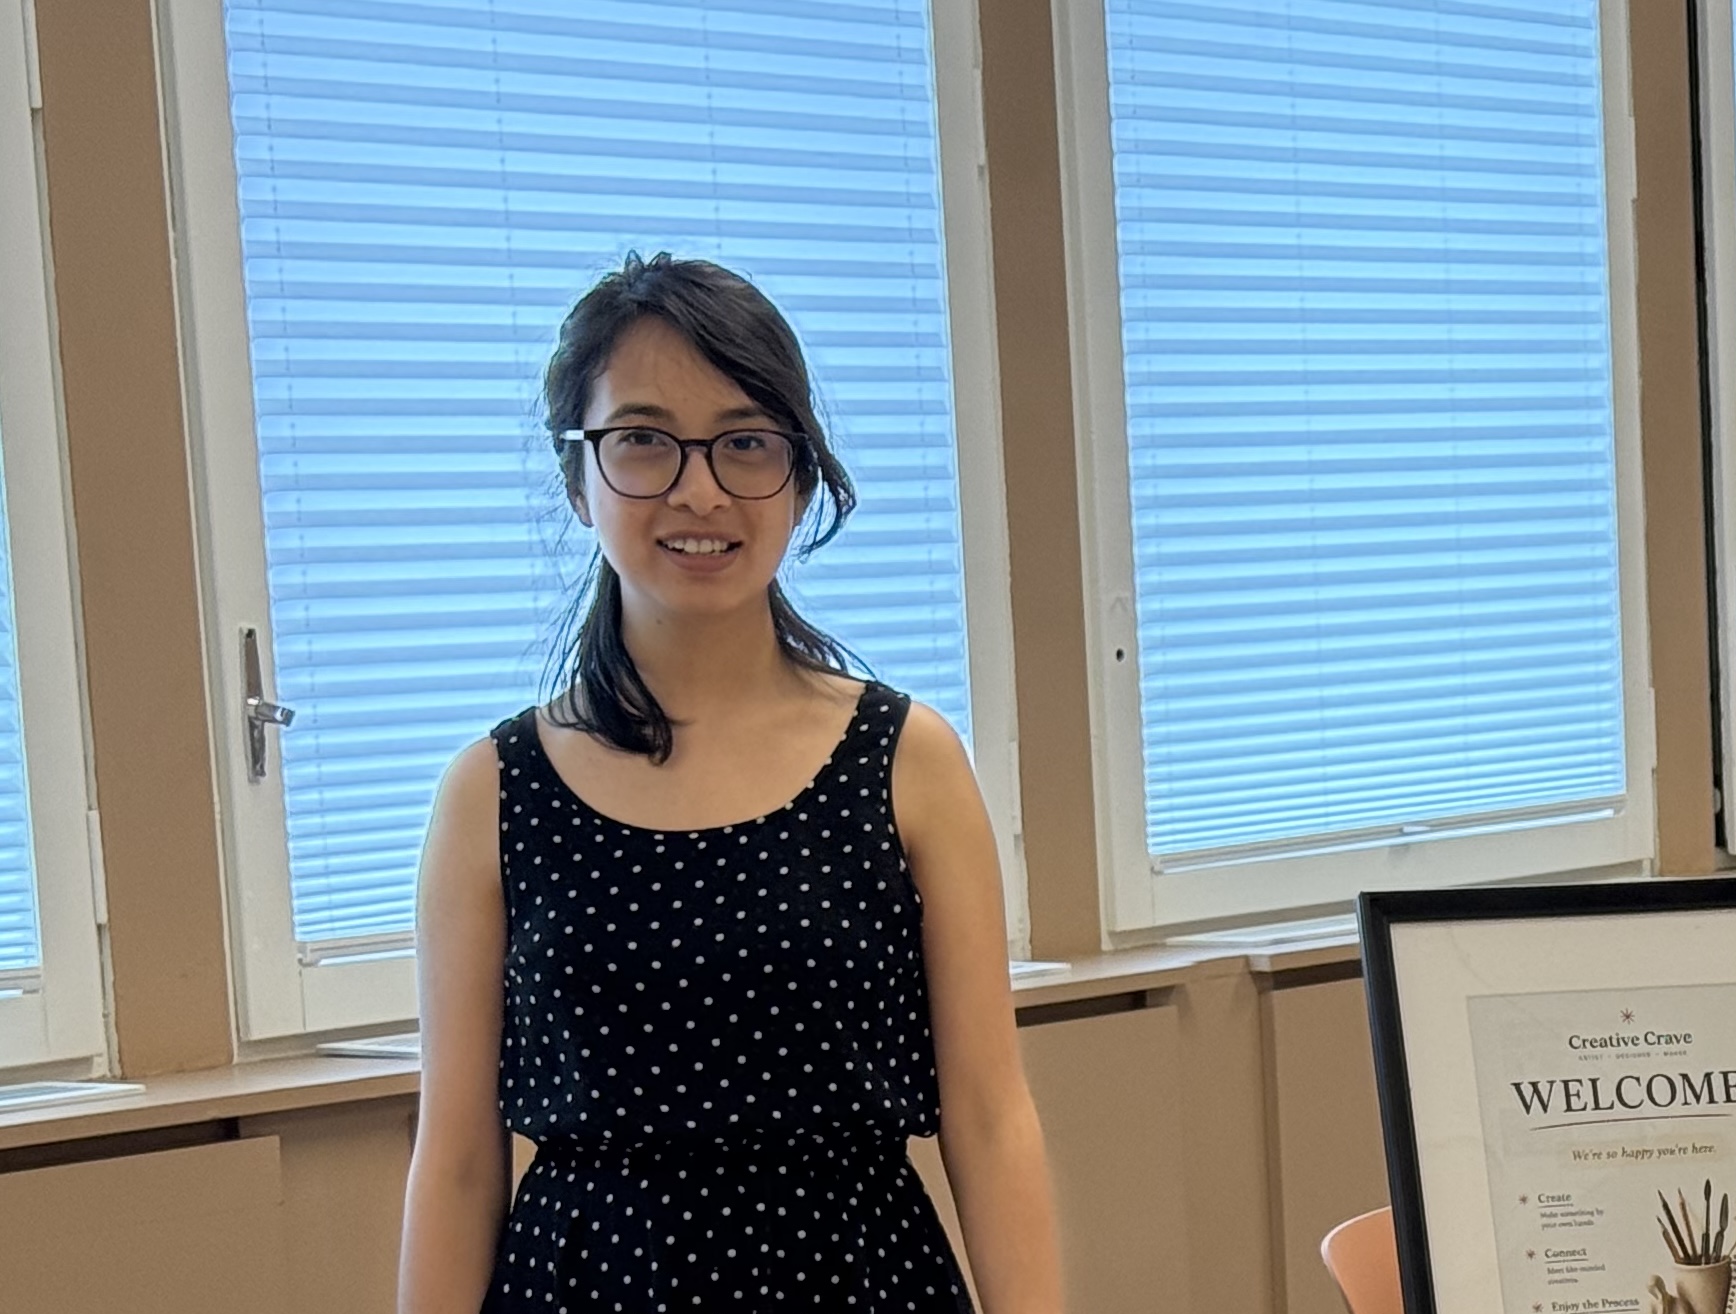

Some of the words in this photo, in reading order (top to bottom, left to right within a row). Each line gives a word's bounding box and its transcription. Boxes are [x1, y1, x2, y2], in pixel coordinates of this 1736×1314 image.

[1568, 1032, 1640, 1050] Creative
[1643, 1030, 1693, 1047] Crave
[1572, 1149, 1602, 1161] We're
[1606, 1150, 1618, 1160] so
[1621, 1146, 1655, 1160] happy
[1656, 1143, 1688, 1159] you're
[1538, 1192, 1572, 1204] Create
[1544, 1248, 1587, 1259] Connect
[1551, 1301, 1580, 1313] Enjoy
[1582, 1299, 1600, 1310] the
[1601, 1297, 1640, 1309] Process
